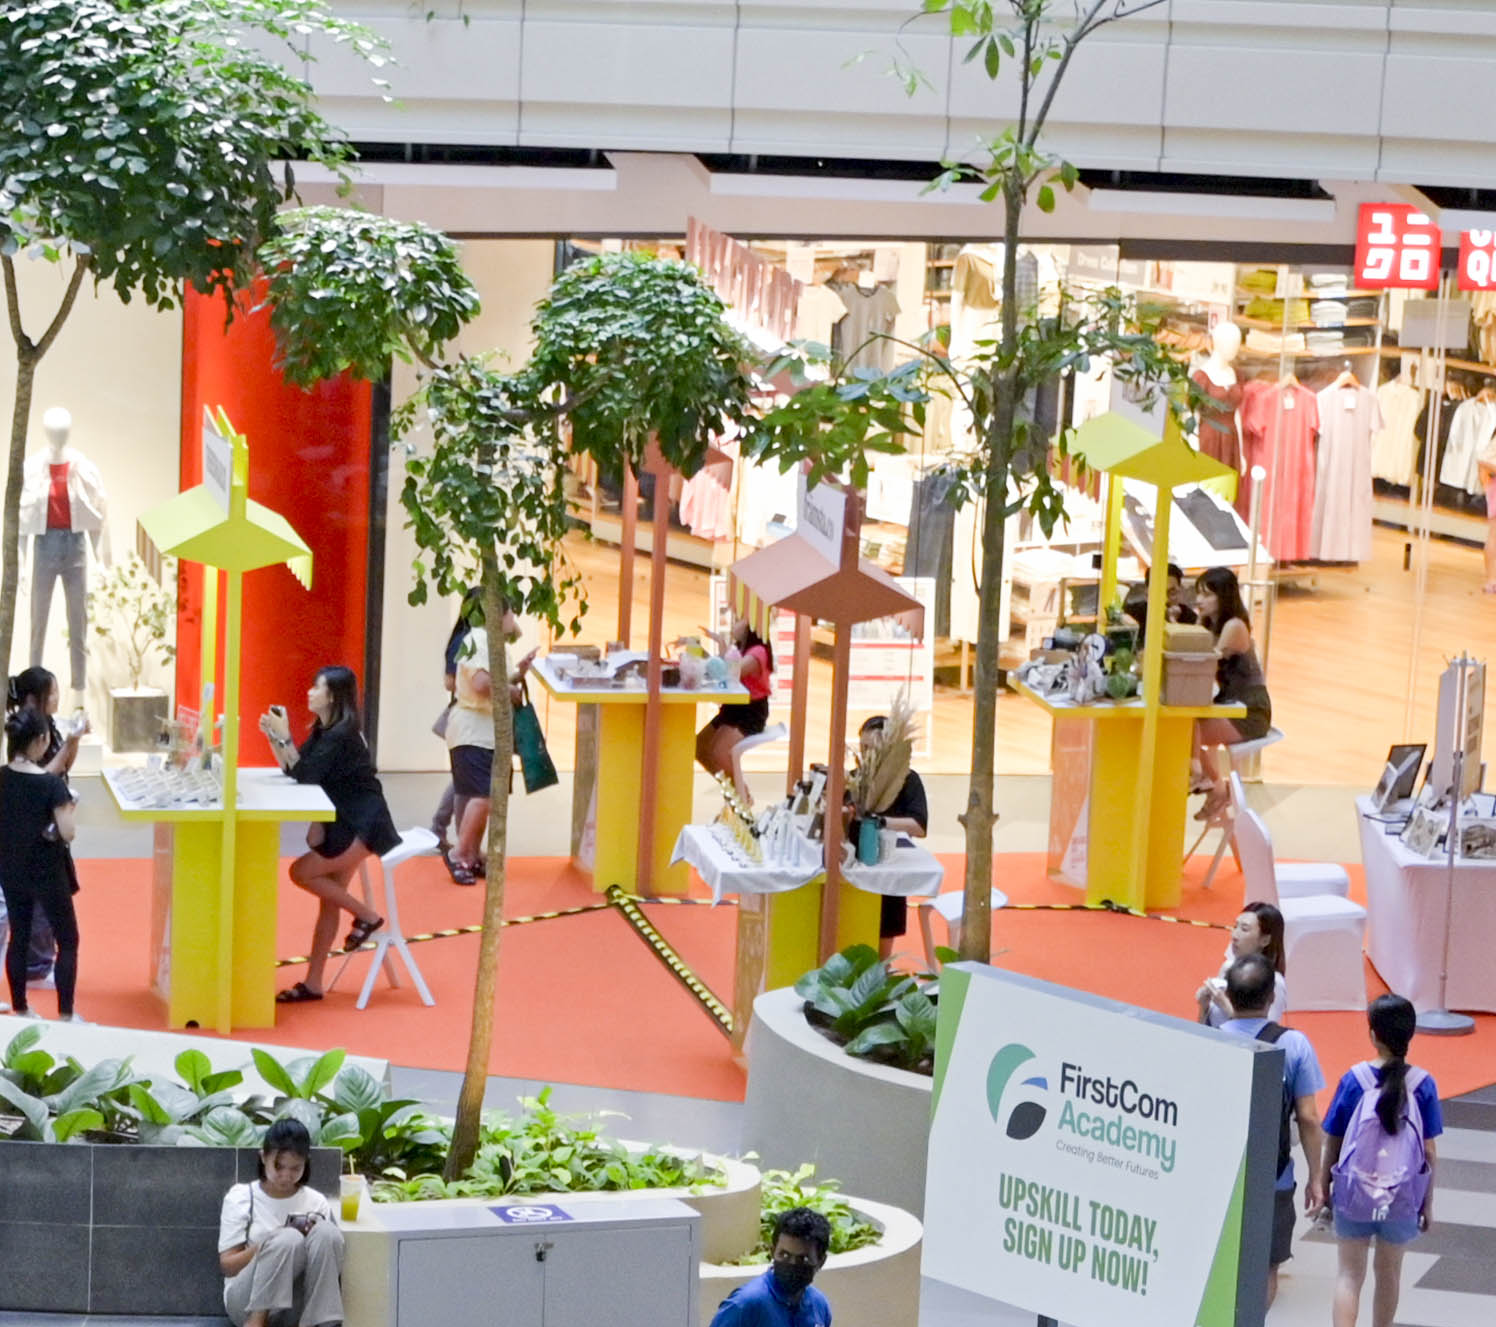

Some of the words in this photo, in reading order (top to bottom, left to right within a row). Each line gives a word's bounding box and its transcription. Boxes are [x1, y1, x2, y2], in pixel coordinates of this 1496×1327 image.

[1060, 1061, 1178, 1127] FirstCom
[1056, 1140, 1094, 1163] Creating
[1096, 1155, 1123, 1169] Better
[1126, 1161, 1159, 1180] Futures
[1058, 1100, 1177, 1173] Academy
[999, 1172, 1082, 1235] UPSKILL
[1089, 1200, 1159, 1263] TODAY,
[1003, 1217, 1054, 1268] SIGN
[1058, 1233, 1086, 1274] UP
[1091, 1245, 1148, 1296] NOW!
